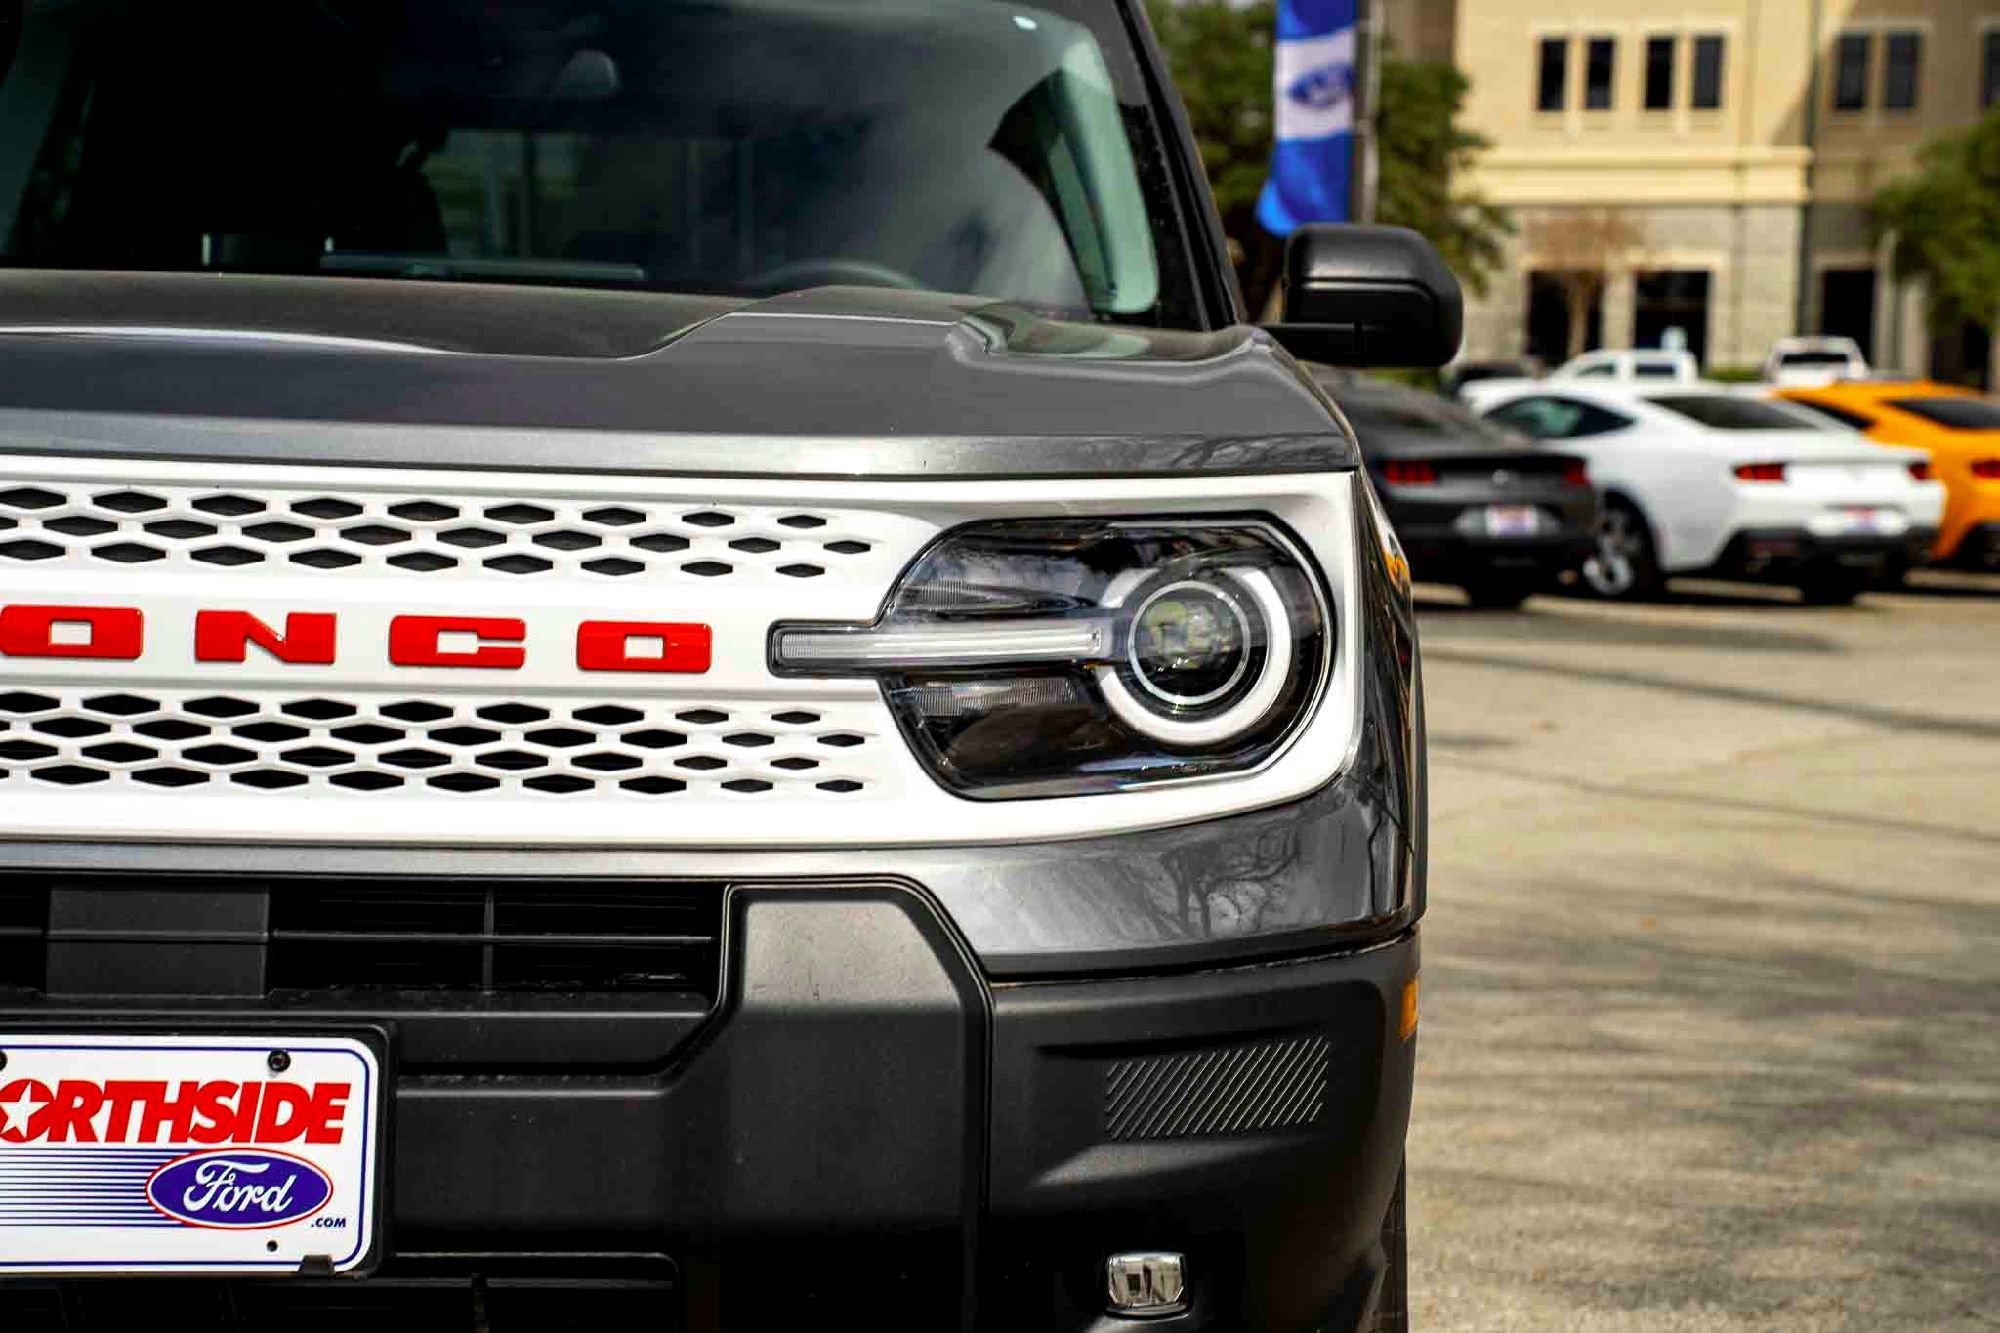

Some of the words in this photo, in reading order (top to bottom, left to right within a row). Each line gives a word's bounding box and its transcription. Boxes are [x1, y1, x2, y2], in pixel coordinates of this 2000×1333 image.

[0, 604, 711, 674] ONCO
[183, 1159, 297, 1212] Ford
[310, 1217, 347, 1228] .COM
